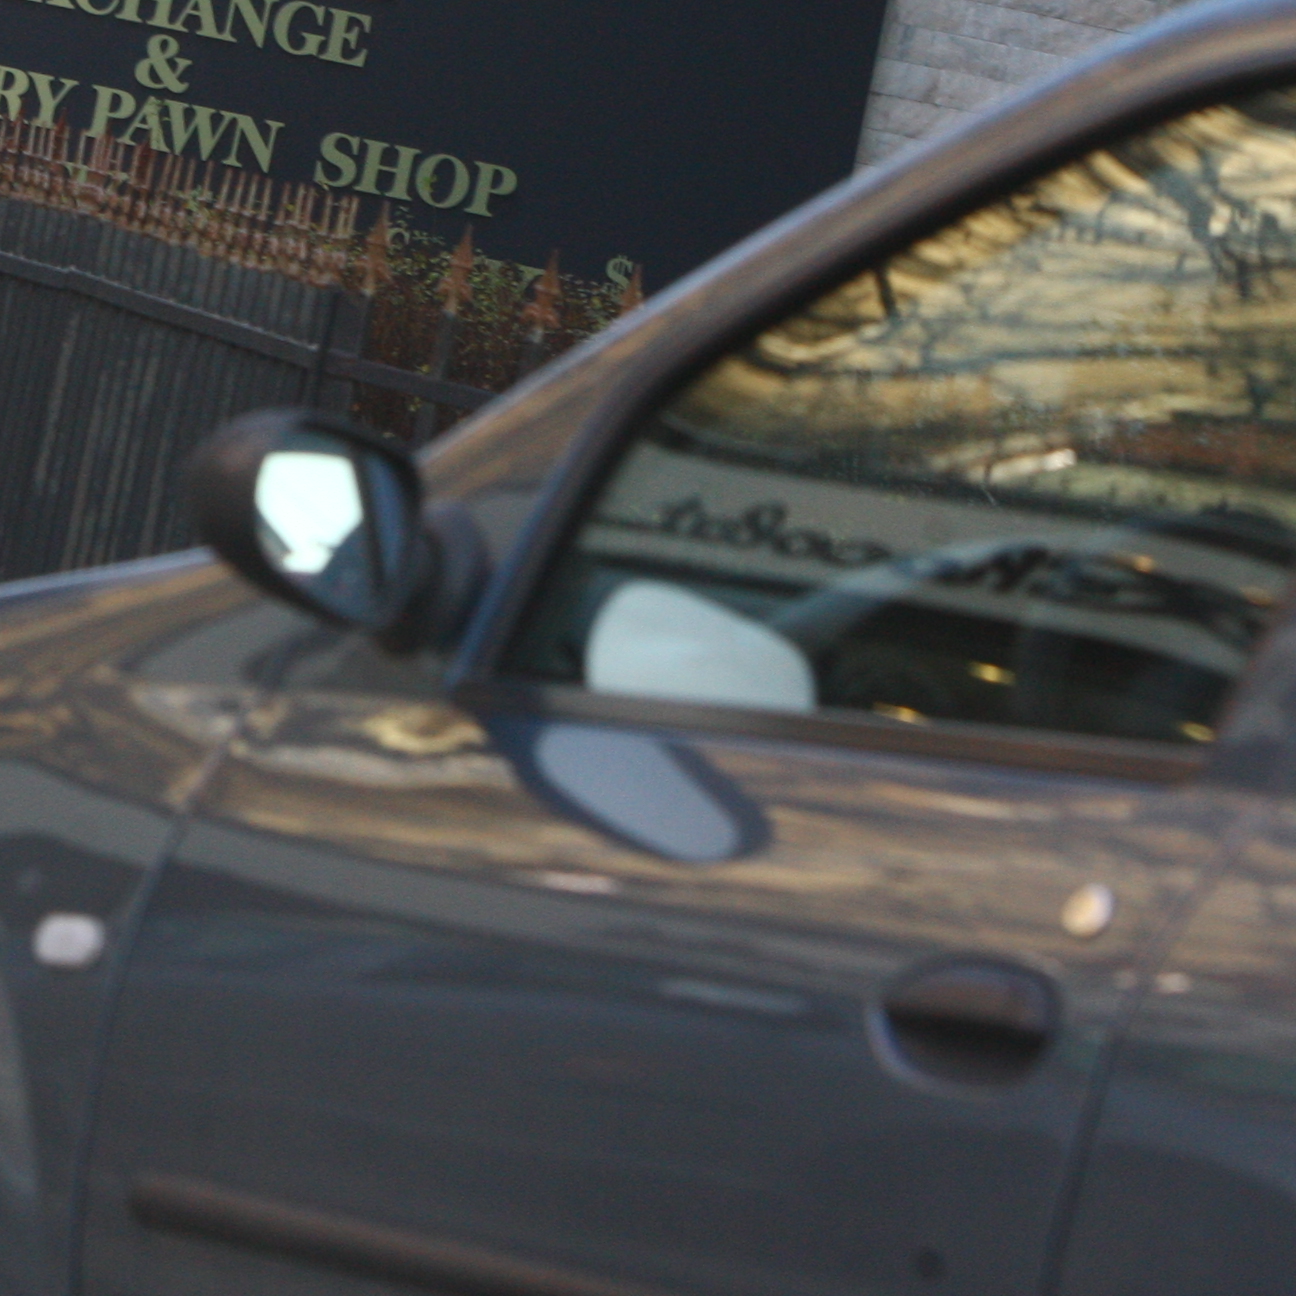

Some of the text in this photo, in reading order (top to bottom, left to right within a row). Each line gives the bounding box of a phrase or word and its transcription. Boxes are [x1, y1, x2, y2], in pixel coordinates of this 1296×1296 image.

[134, 33, 193, 94] &
[85, 83, 285, 174] PAWN
[314, 131, 518, 218] SHOP
